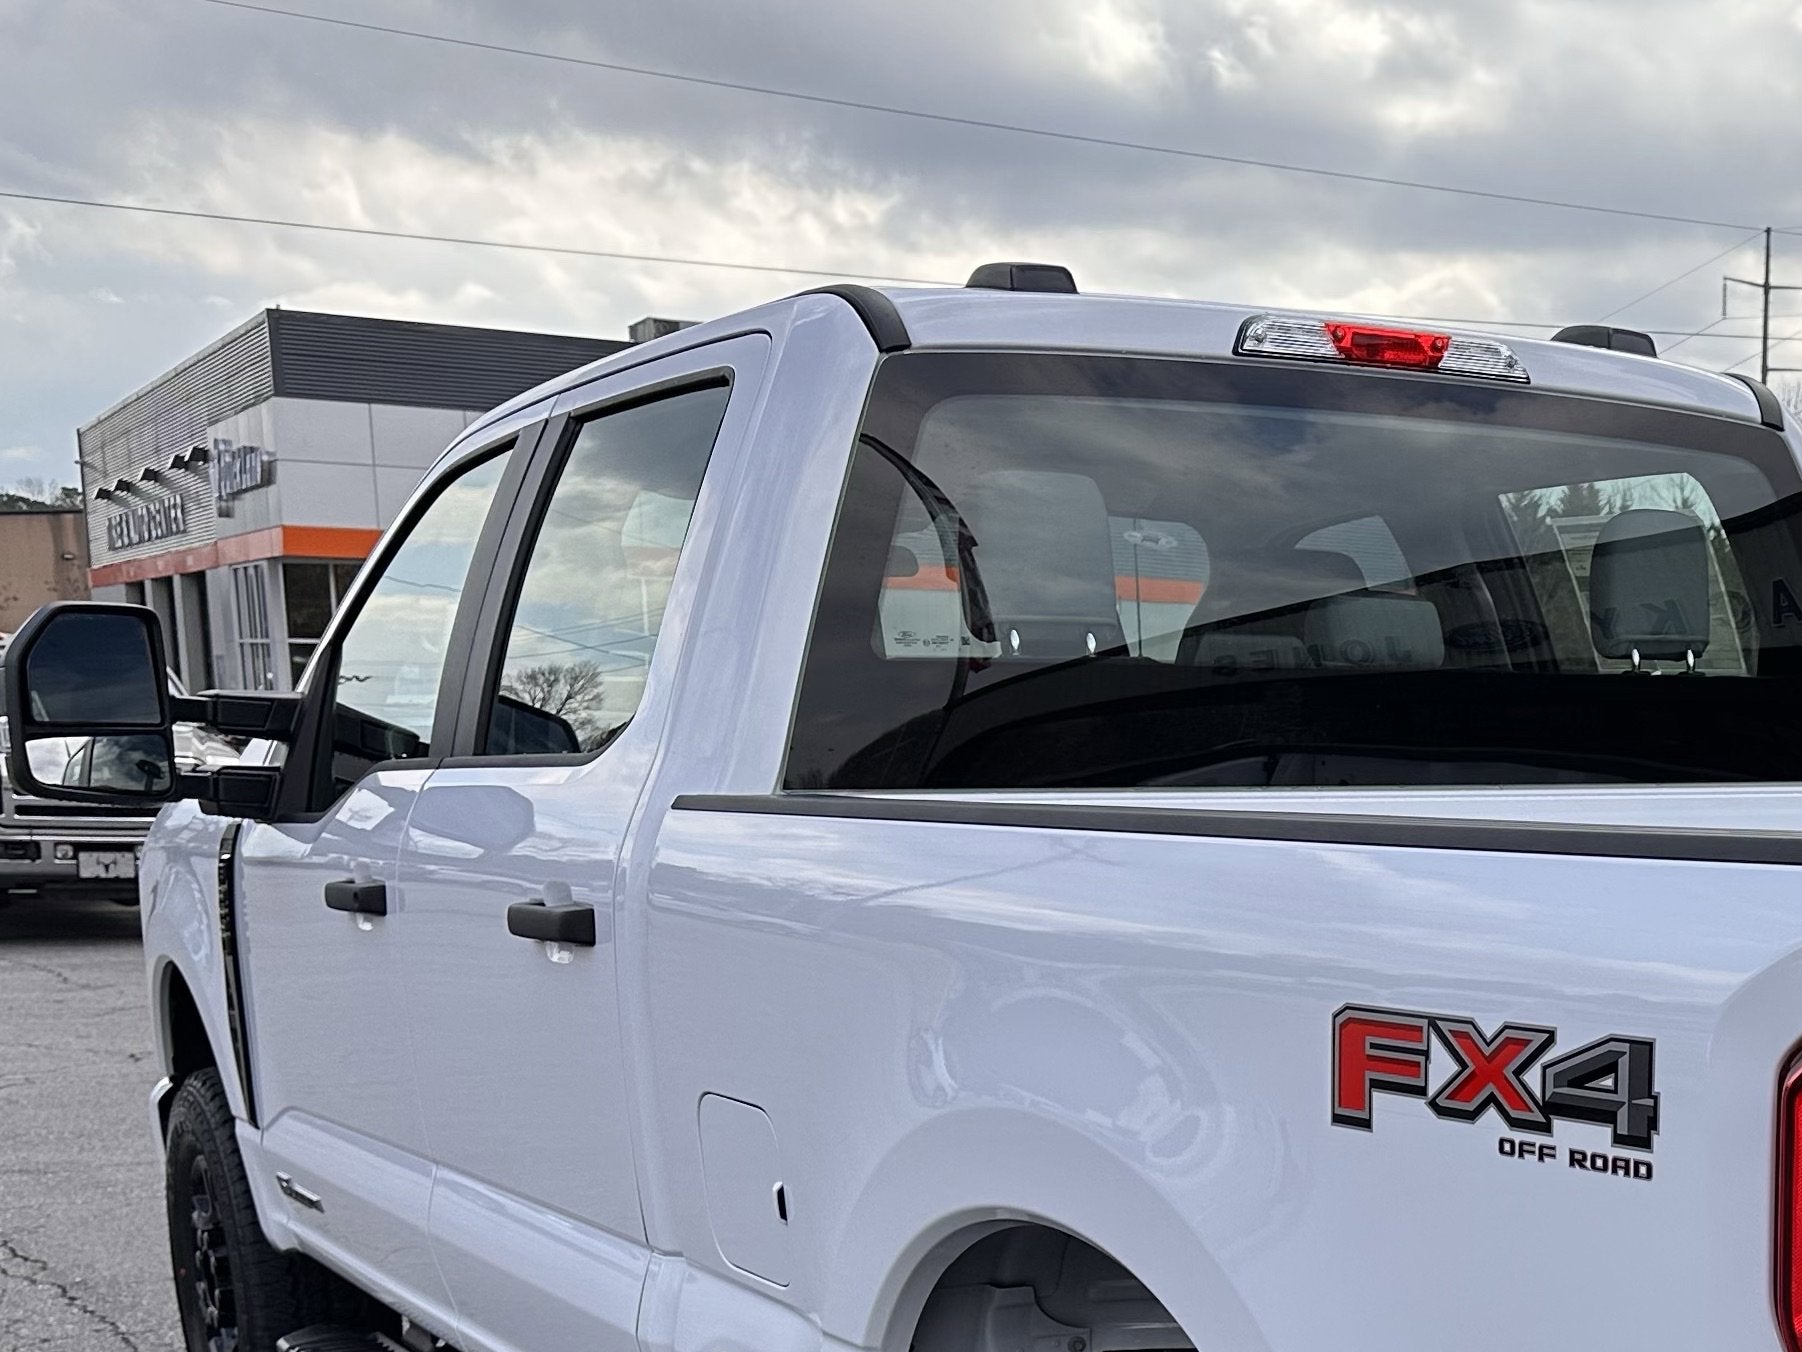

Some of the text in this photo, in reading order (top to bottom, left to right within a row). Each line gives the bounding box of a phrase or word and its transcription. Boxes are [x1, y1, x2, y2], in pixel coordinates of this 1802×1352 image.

[1331, 1002, 1661, 1153] FX4
[1498, 1136, 1655, 1181] OFF ROAD
